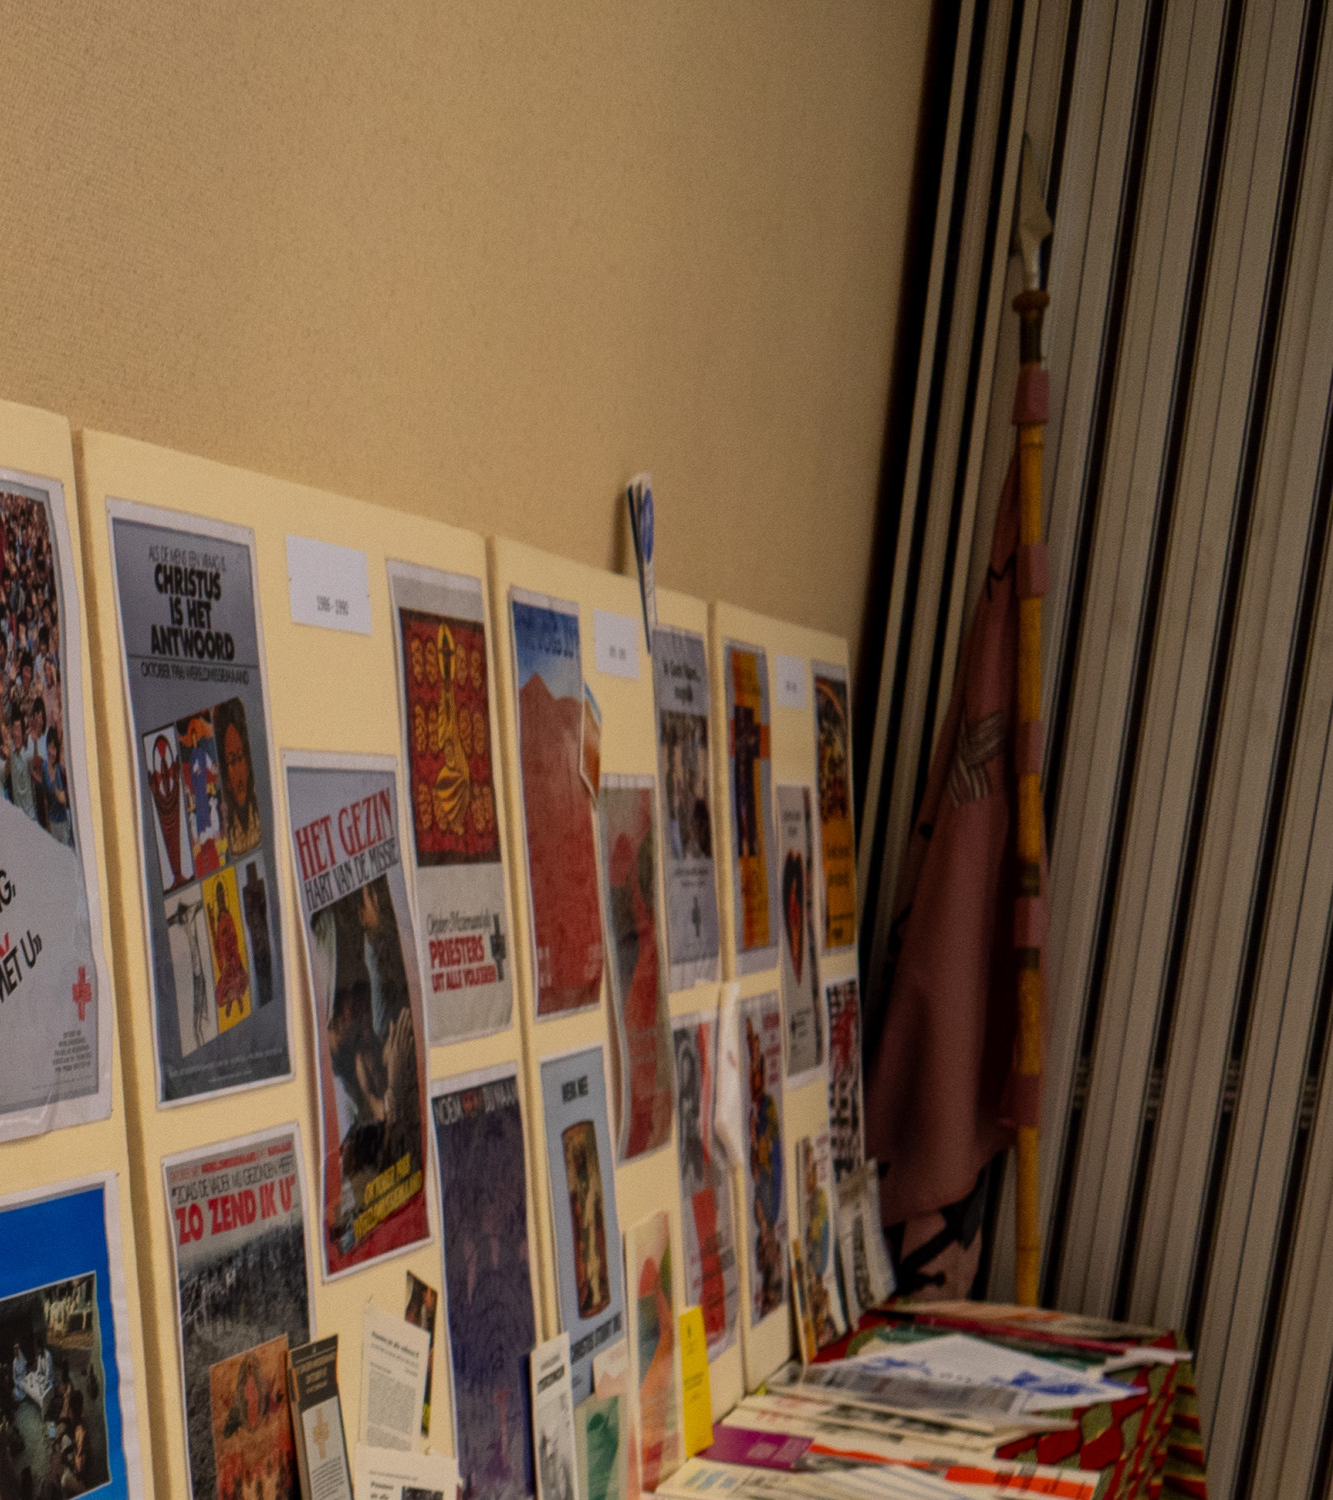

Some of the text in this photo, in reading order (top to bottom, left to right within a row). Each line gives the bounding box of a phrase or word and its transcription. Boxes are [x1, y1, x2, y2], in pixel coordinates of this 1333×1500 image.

[154, 563, 222, 601] CHRISTUS
[169, 596, 212, 629] IS HET
[150, 624, 235, 661] ANTWOORD
[294, 786, 394, 881] HET GEZIN
[304, 871, 333, 911] HART
[333, 860, 354, 896] VAN
[353, 853, 370, 886] DE
[429, 934, 485, 970] PRIESTERS
